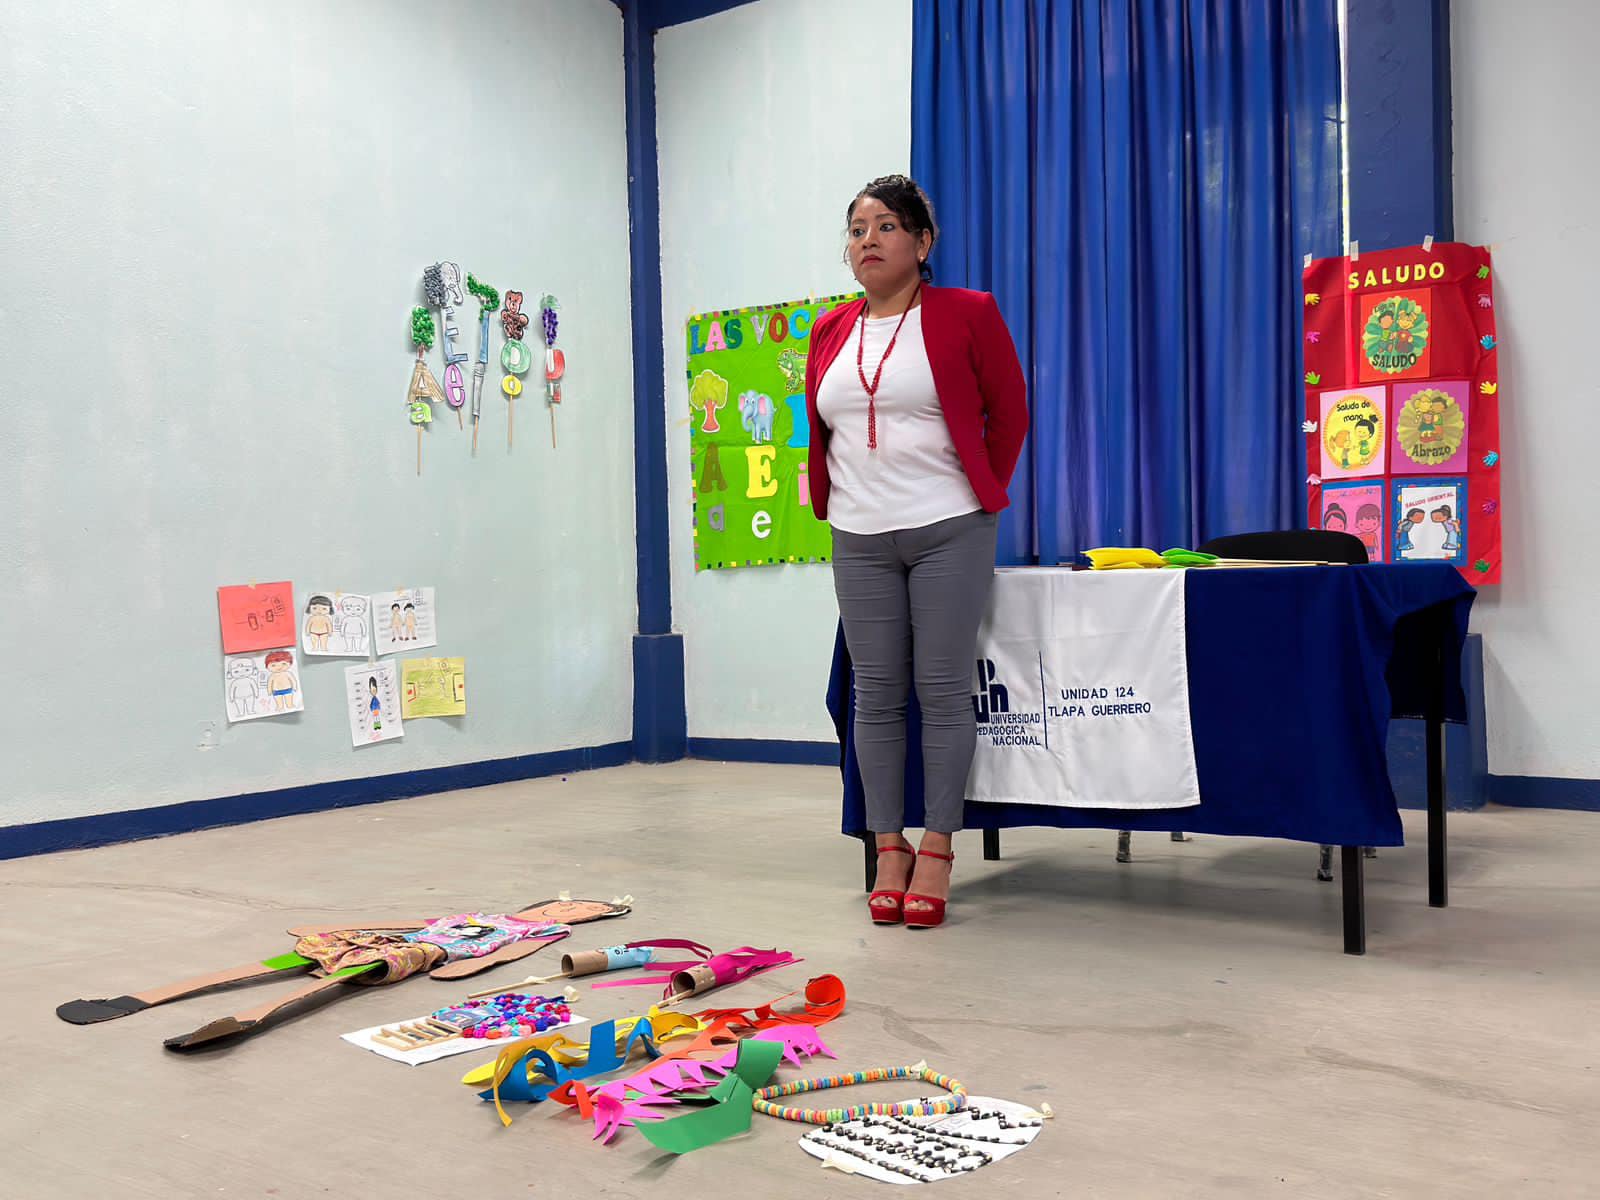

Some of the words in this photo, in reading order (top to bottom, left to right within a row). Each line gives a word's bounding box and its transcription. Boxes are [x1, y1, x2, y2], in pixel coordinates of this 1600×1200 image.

[1347, 261, 1446, 290] SALUDO
[689, 318, 743, 355] LAS
[1372, 353, 1417, 368] SALUDO
[408, 362, 444, 403] A
[410, 402, 432, 423] a
[1336, 400, 1360, 413] Saludo
[1361, 400, 1371, 409] de
[1411, 444, 1451, 458] Abrazo
[700, 444, 728, 493] A
[745, 445, 778, 498] E
[798, 463, 809, 506] i
[751, 510, 772, 538] e
[1061, 687, 1108, 700] UNIDAD
[1115, 686, 1135, 698] 124
[1048, 705, 1085, 717] TLAPA
[1091, 702, 1152, 716] GUERRERO
[990, 712, 1041, 725] UNIVERSIDAD
[992, 735, 1041, 746] NACIONAL
